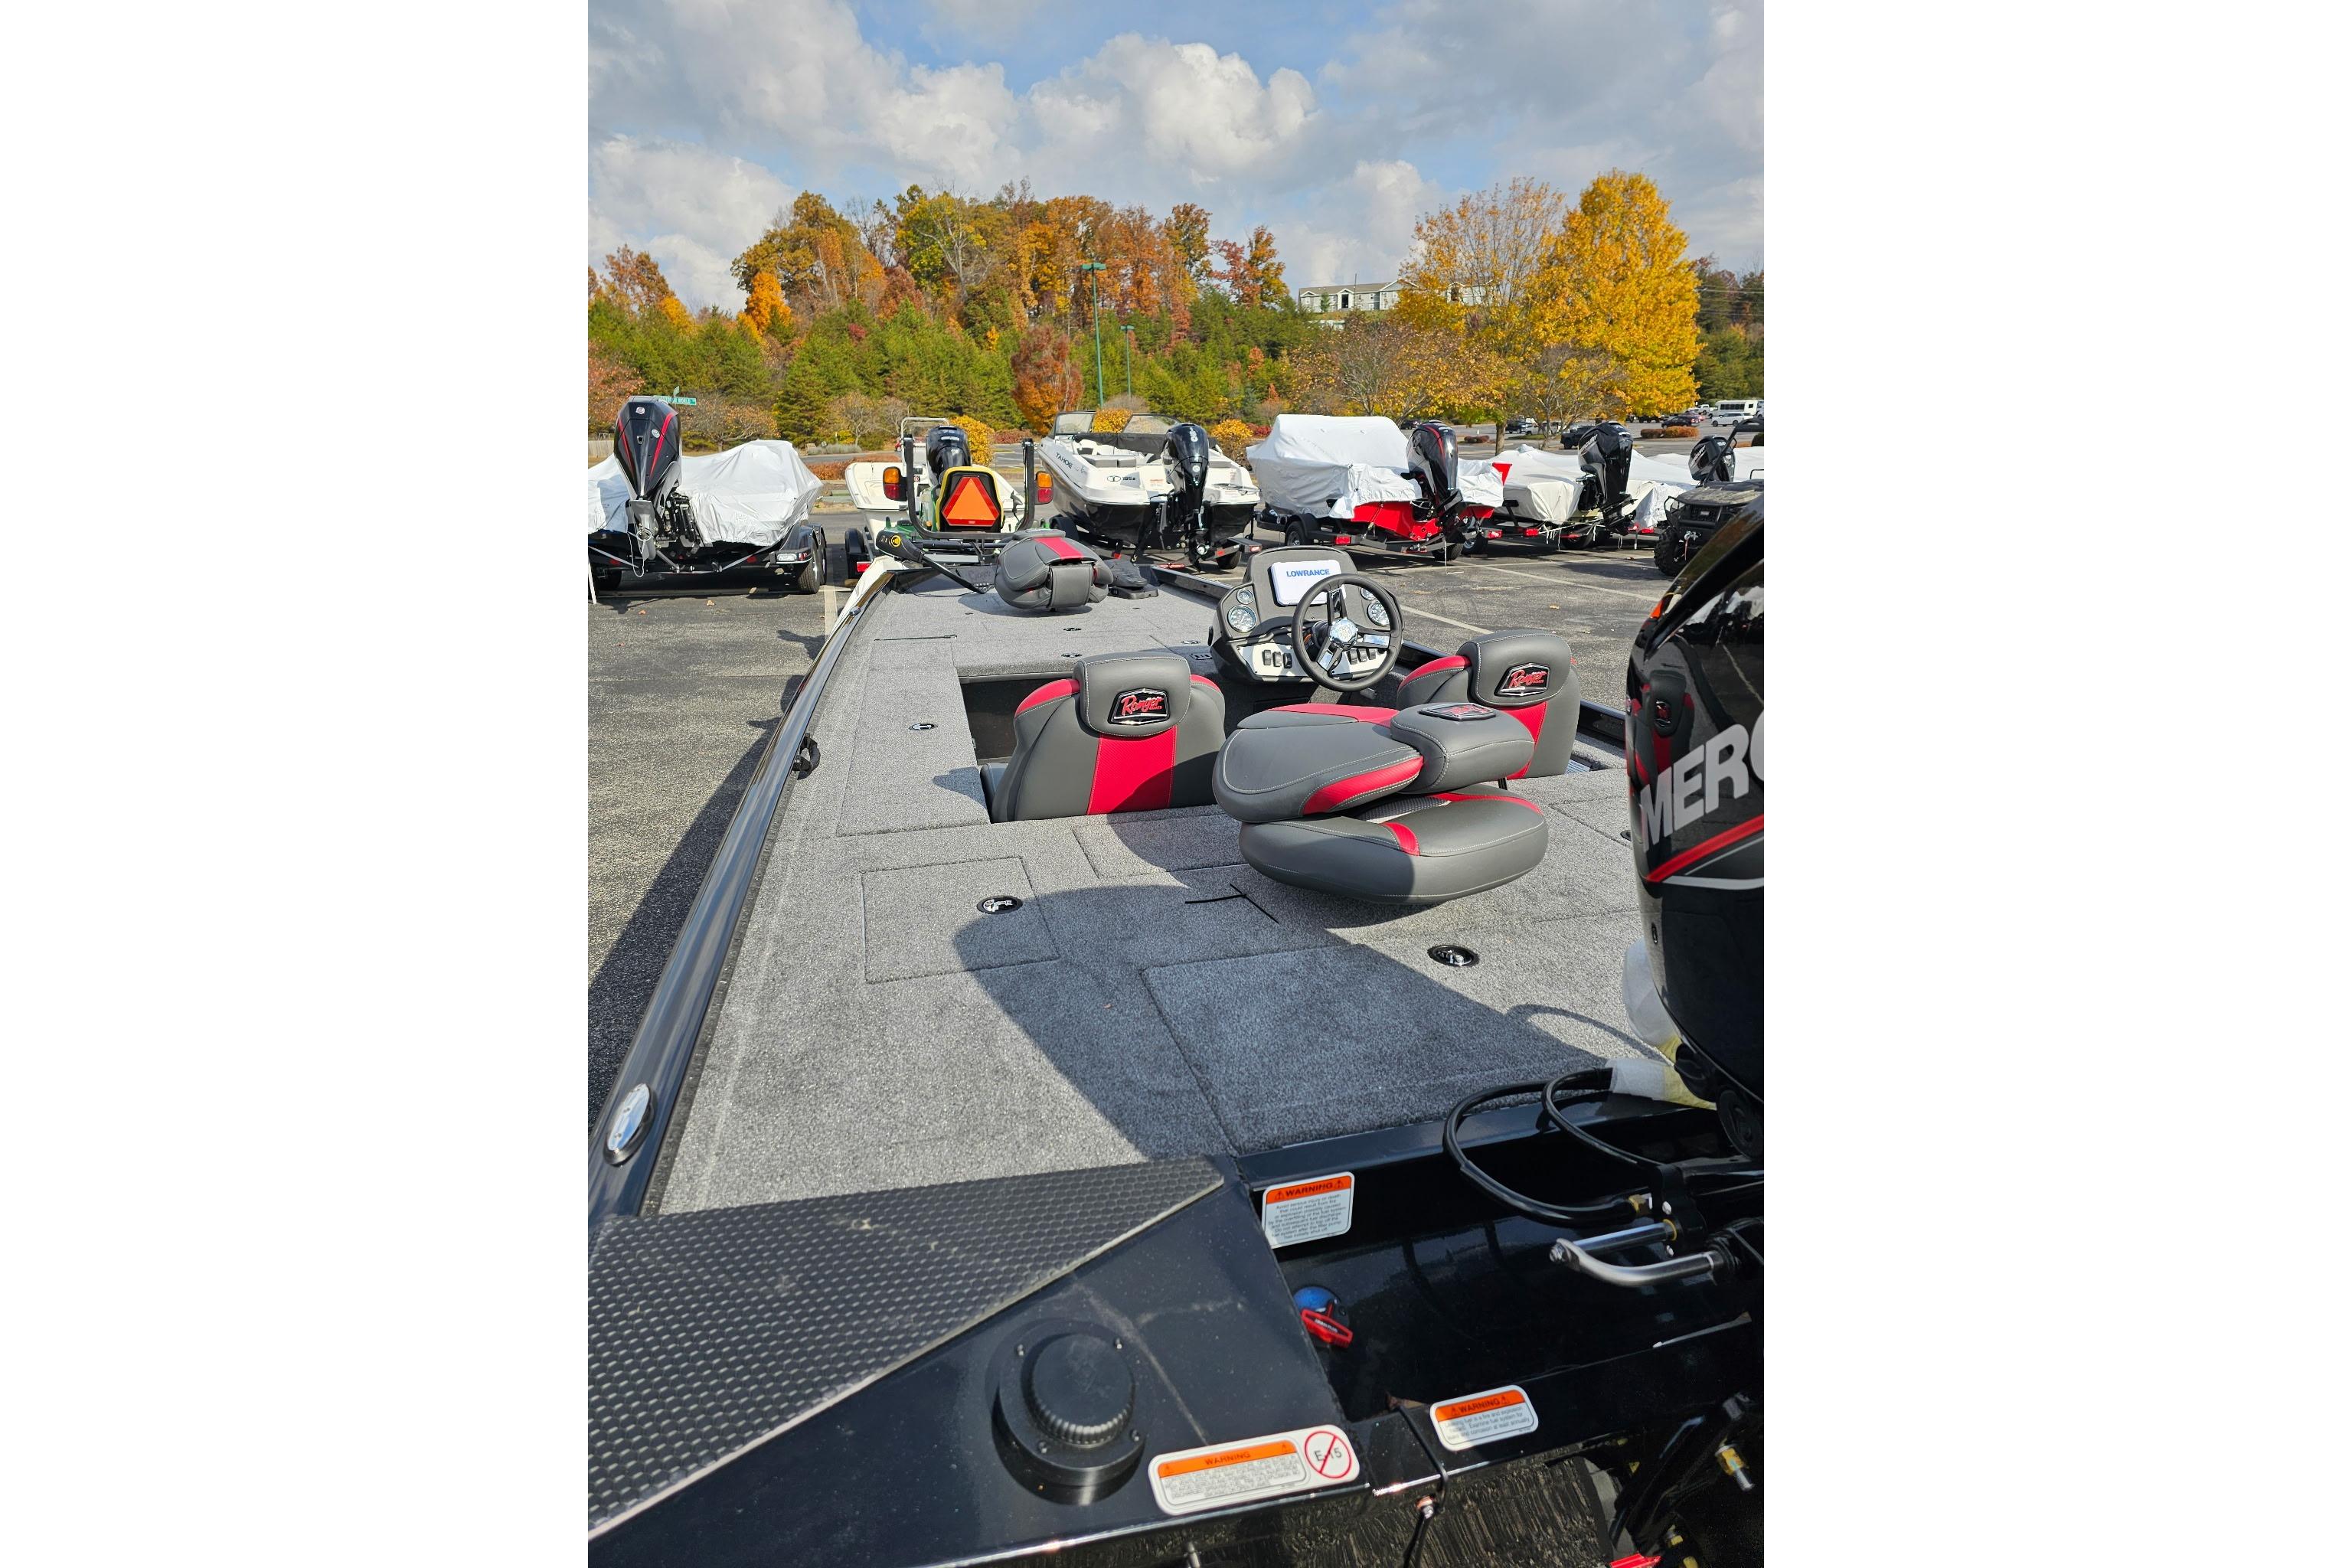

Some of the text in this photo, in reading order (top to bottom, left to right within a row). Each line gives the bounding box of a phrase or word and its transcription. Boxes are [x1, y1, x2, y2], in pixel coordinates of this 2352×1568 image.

[1057, 452, 1073, 469] TAHOE
[1509, 669, 1547, 689] Ranger
[1121, 695, 1162, 716] Ranger
[1285, 1182, 1333, 1197] WARNING
[1459, 1397, 1500, 1413] WARNING
[1204, 1452, 1251, 1466] WARNING
